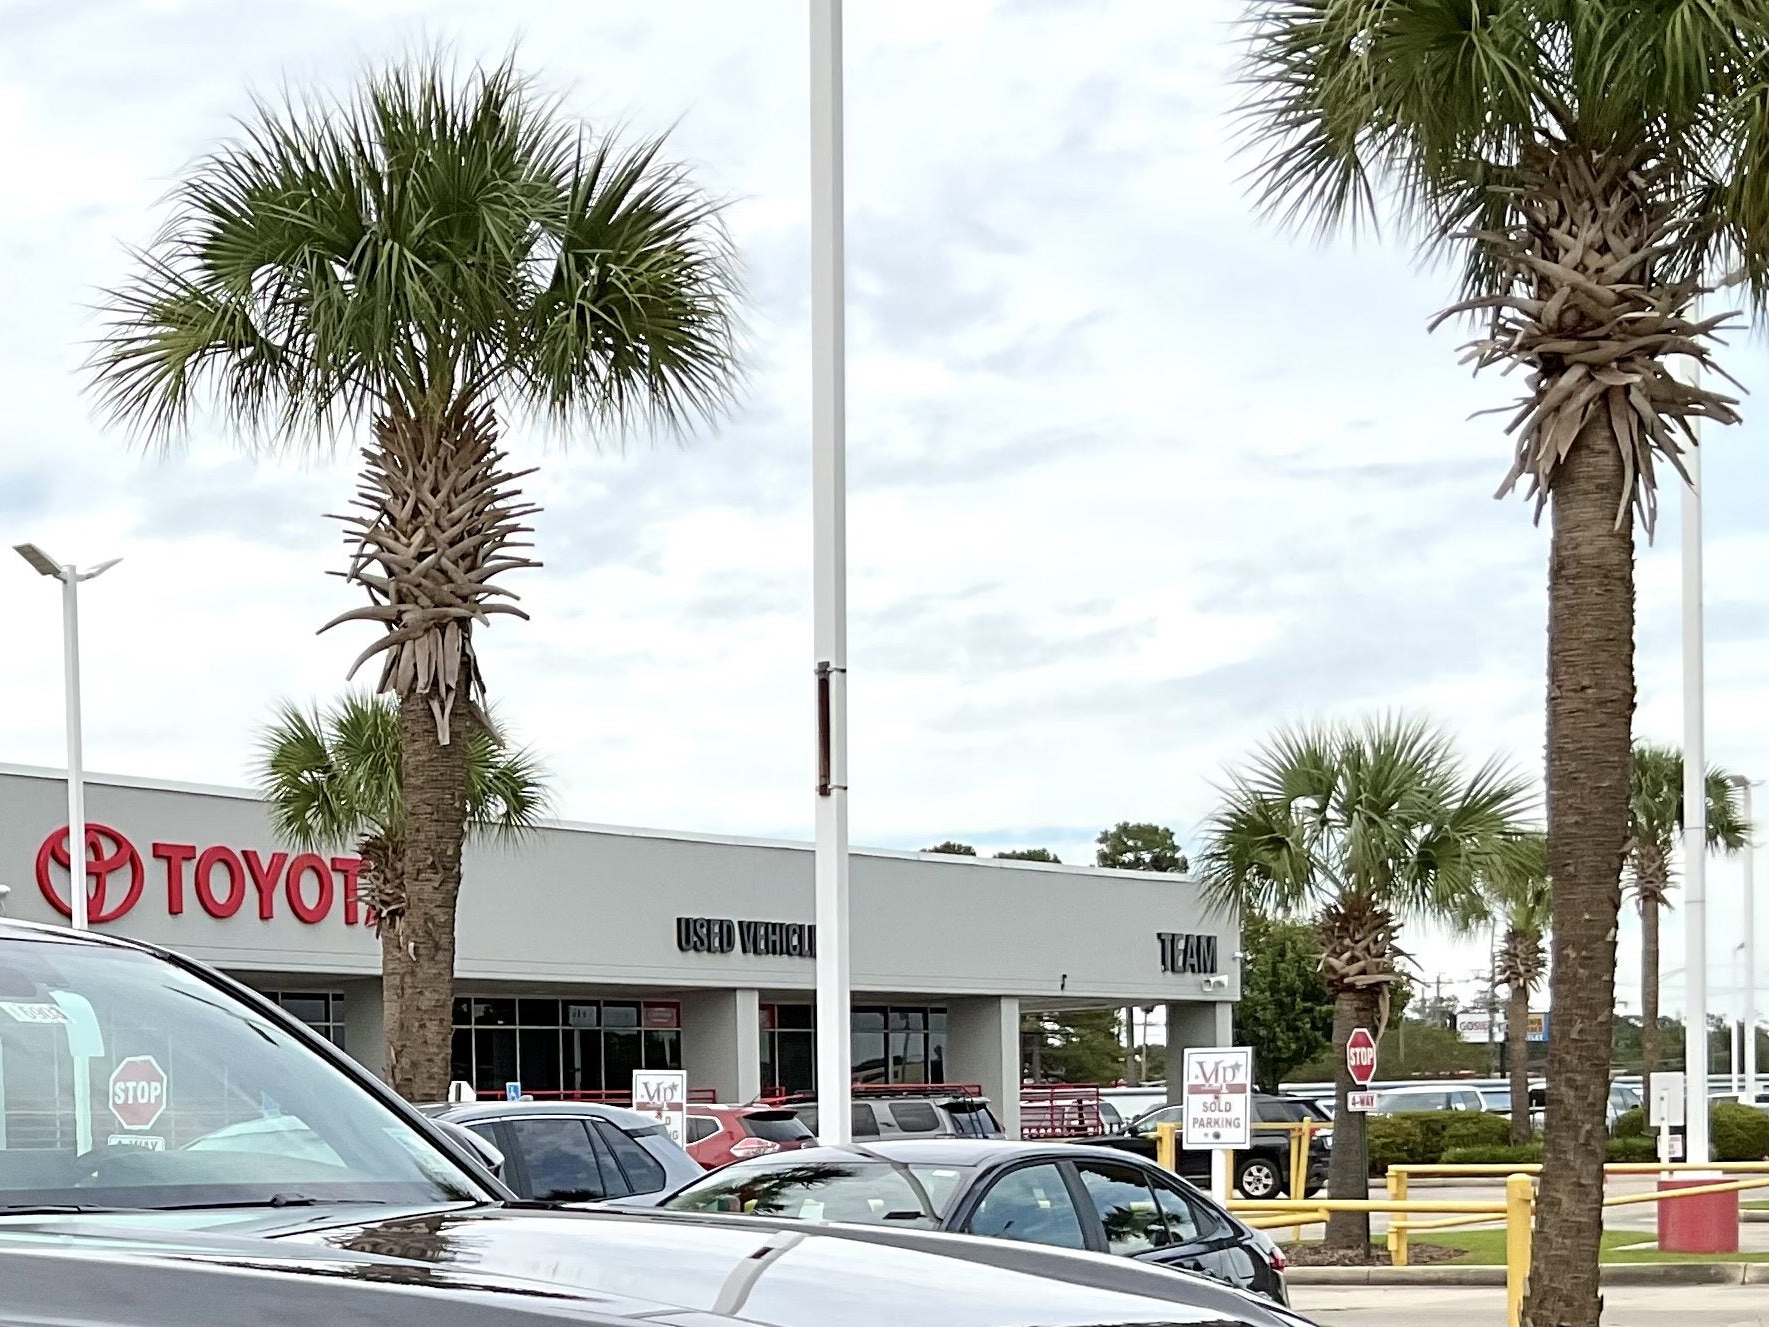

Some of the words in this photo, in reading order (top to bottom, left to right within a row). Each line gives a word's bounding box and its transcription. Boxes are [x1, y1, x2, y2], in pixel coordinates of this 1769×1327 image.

[152, 842, 379, 928] TOYOT
[677, 917, 736, 953] USED
[1156, 932, 1217, 974] TEAM
[1349, 1047, 1373, 1066] STOP
[114, 1081, 161, 1104] STOP
[1351, 1095, 1374, 1107] 4-WAY
[1202, 1101, 1232, 1113] SOLD
[1192, 1117, 1241, 1129] PARKING
